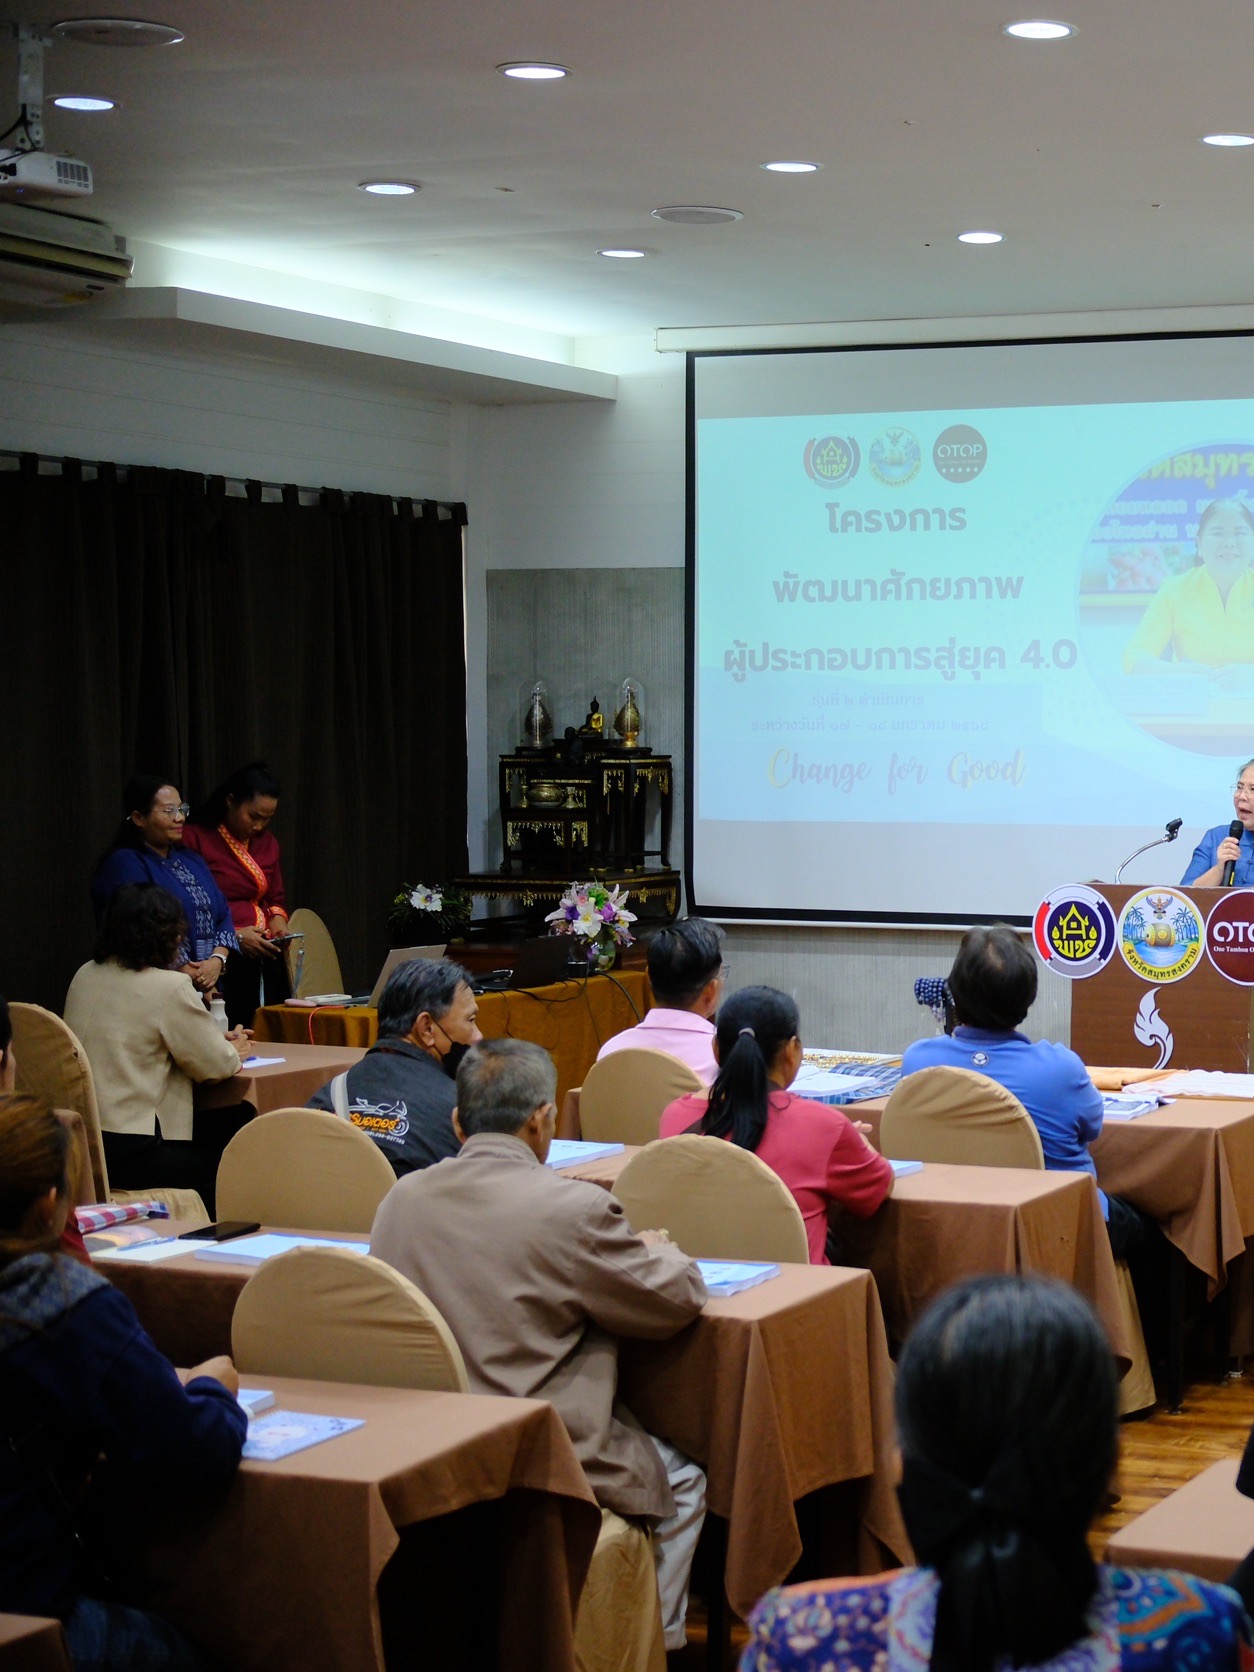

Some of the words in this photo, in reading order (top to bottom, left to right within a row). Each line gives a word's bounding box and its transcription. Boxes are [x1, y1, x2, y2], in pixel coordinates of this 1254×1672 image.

[937, 444, 983, 458] OTOP
[825, 502, 968, 535] โครงการ
[772, 567, 1025, 604] พัฒนาศักยภาพ
[724, 638, 1007, 684] ผู้ประกอบการสู่ยุค
[1020, 638, 1079, 671] 4.0
[769, 747, 873, 795] Change
[887, 751, 929, 796] for
[946, 748, 1026, 789] Good
[1126, 946, 1198, 980] จังหวัดสมุทรสงคราม
[1213, 945, 1225, 953] One
